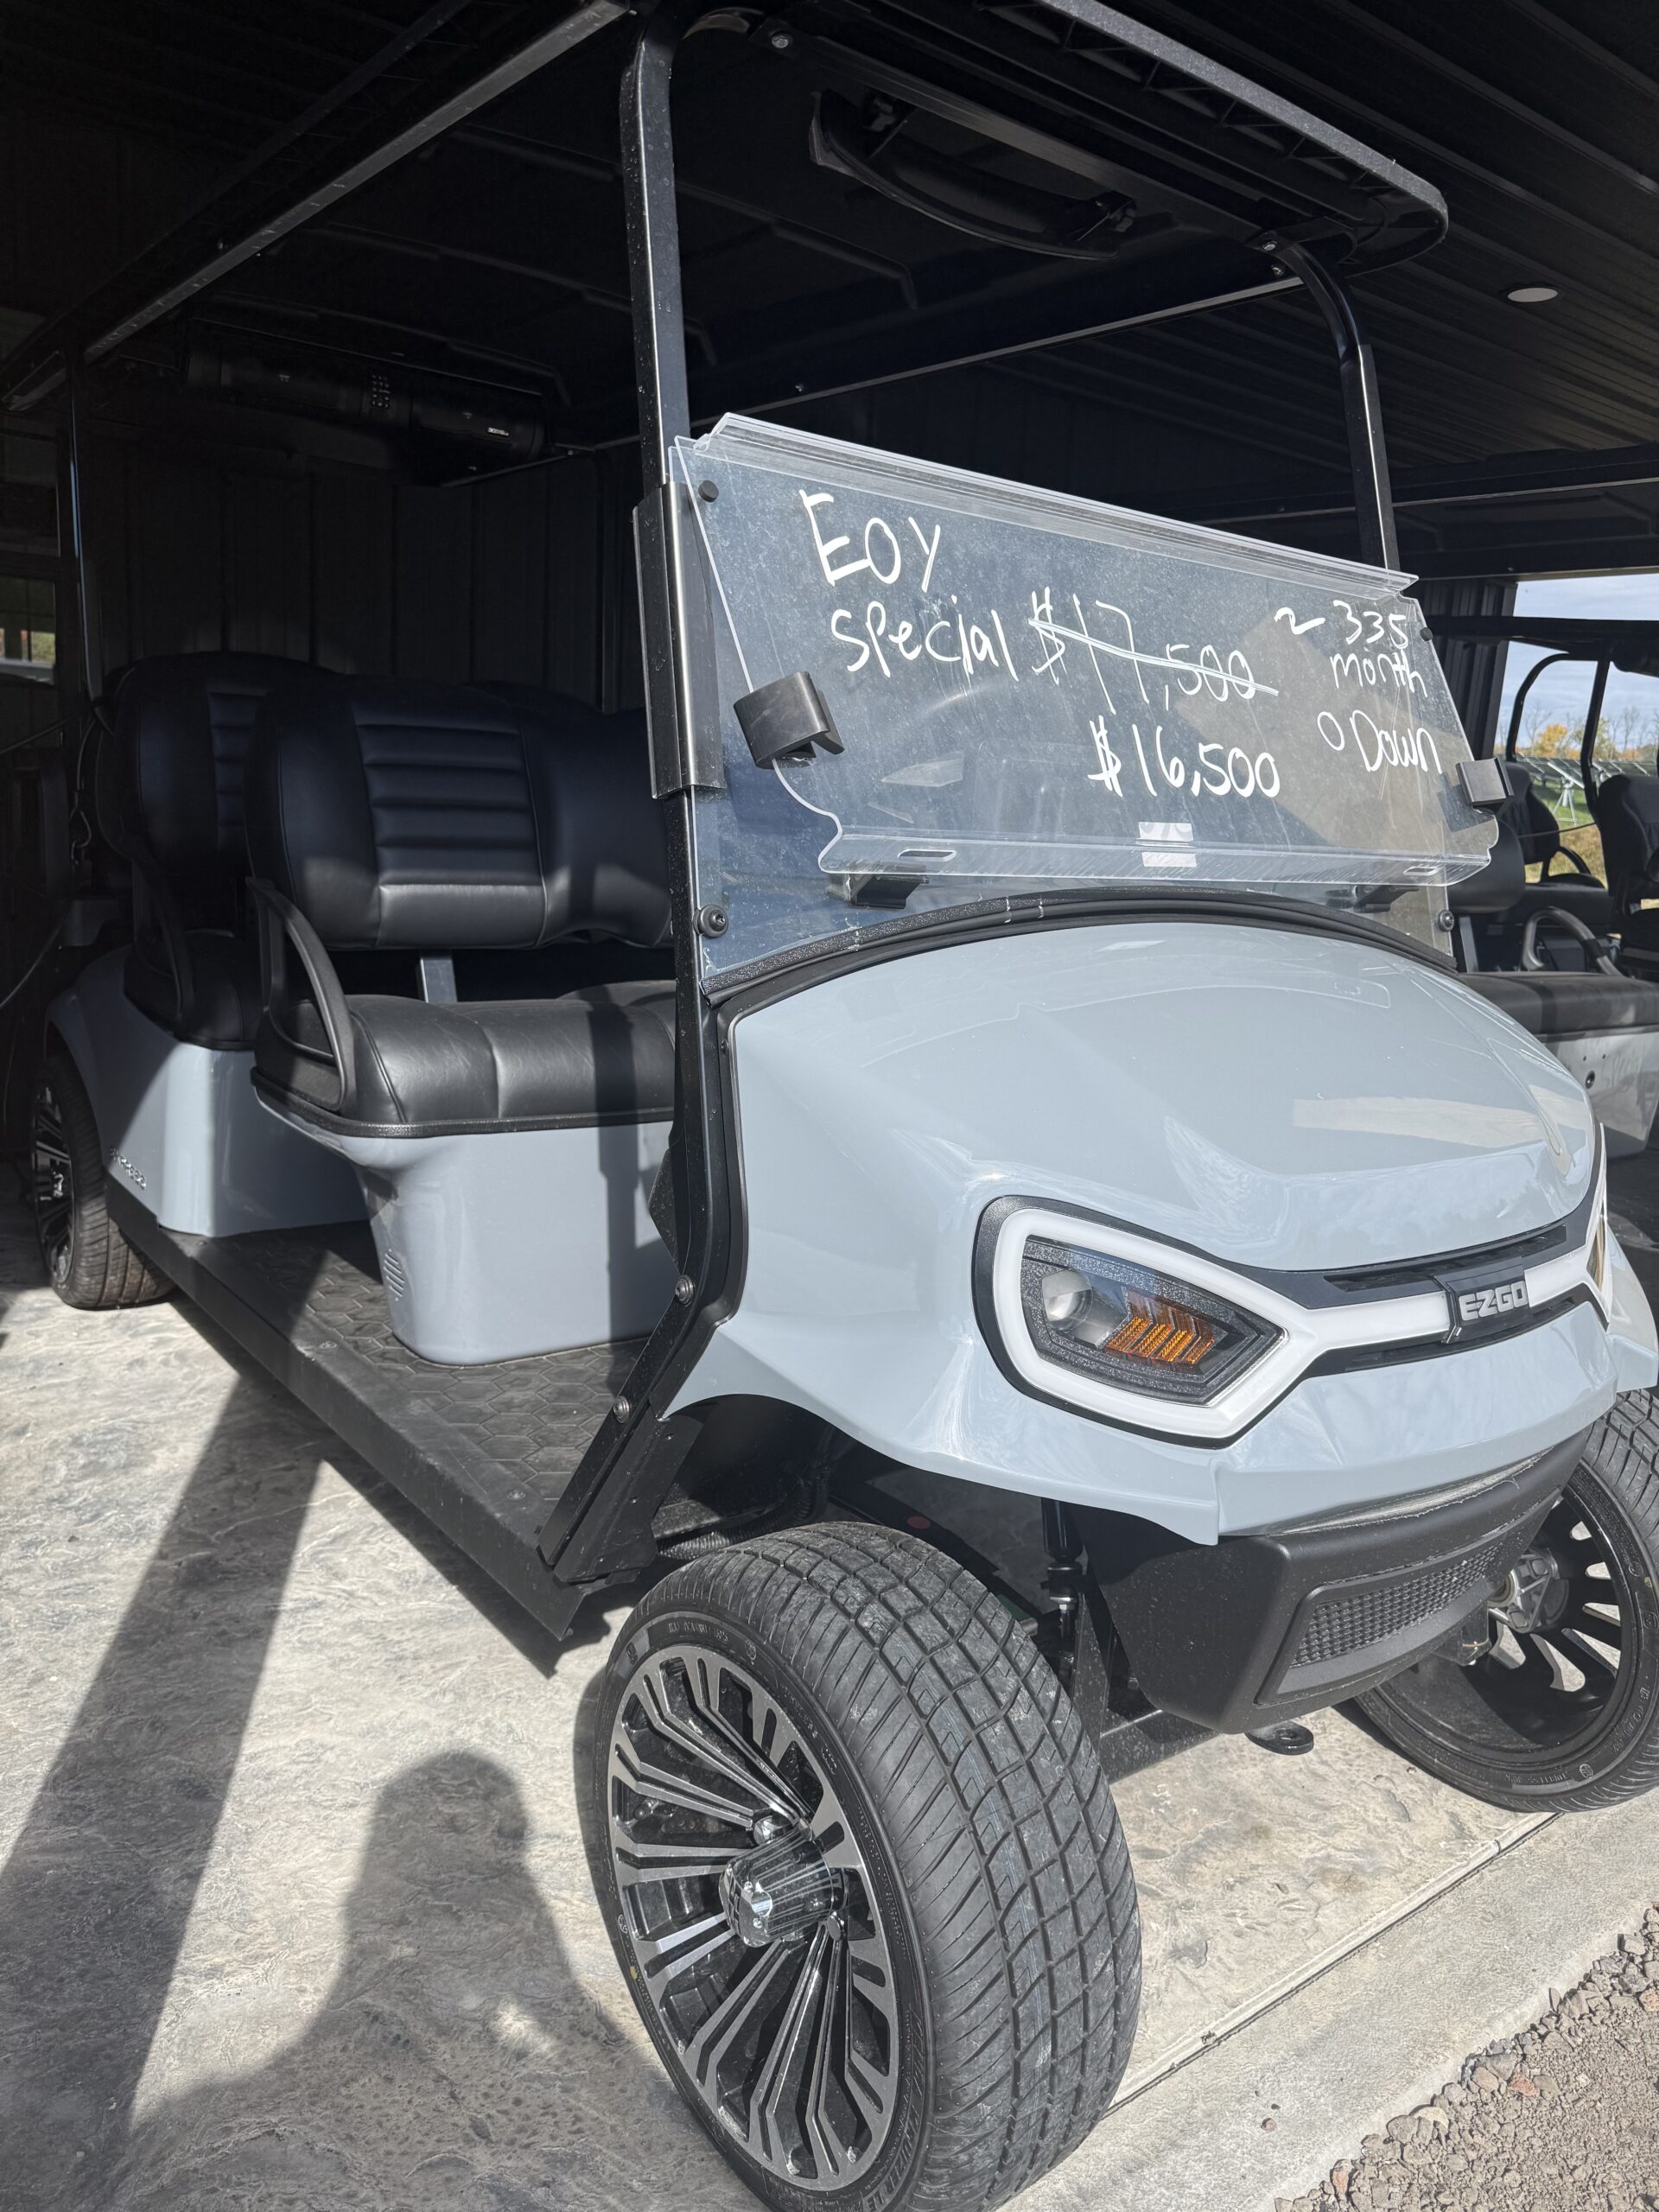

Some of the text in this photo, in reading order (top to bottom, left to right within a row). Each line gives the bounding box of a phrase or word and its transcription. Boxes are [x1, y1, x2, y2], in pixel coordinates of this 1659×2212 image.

[1332, 600, 1409, 649] 335
[1087, 715, 1281, 798] $16,500
[1349, 709, 1443, 775] Down
